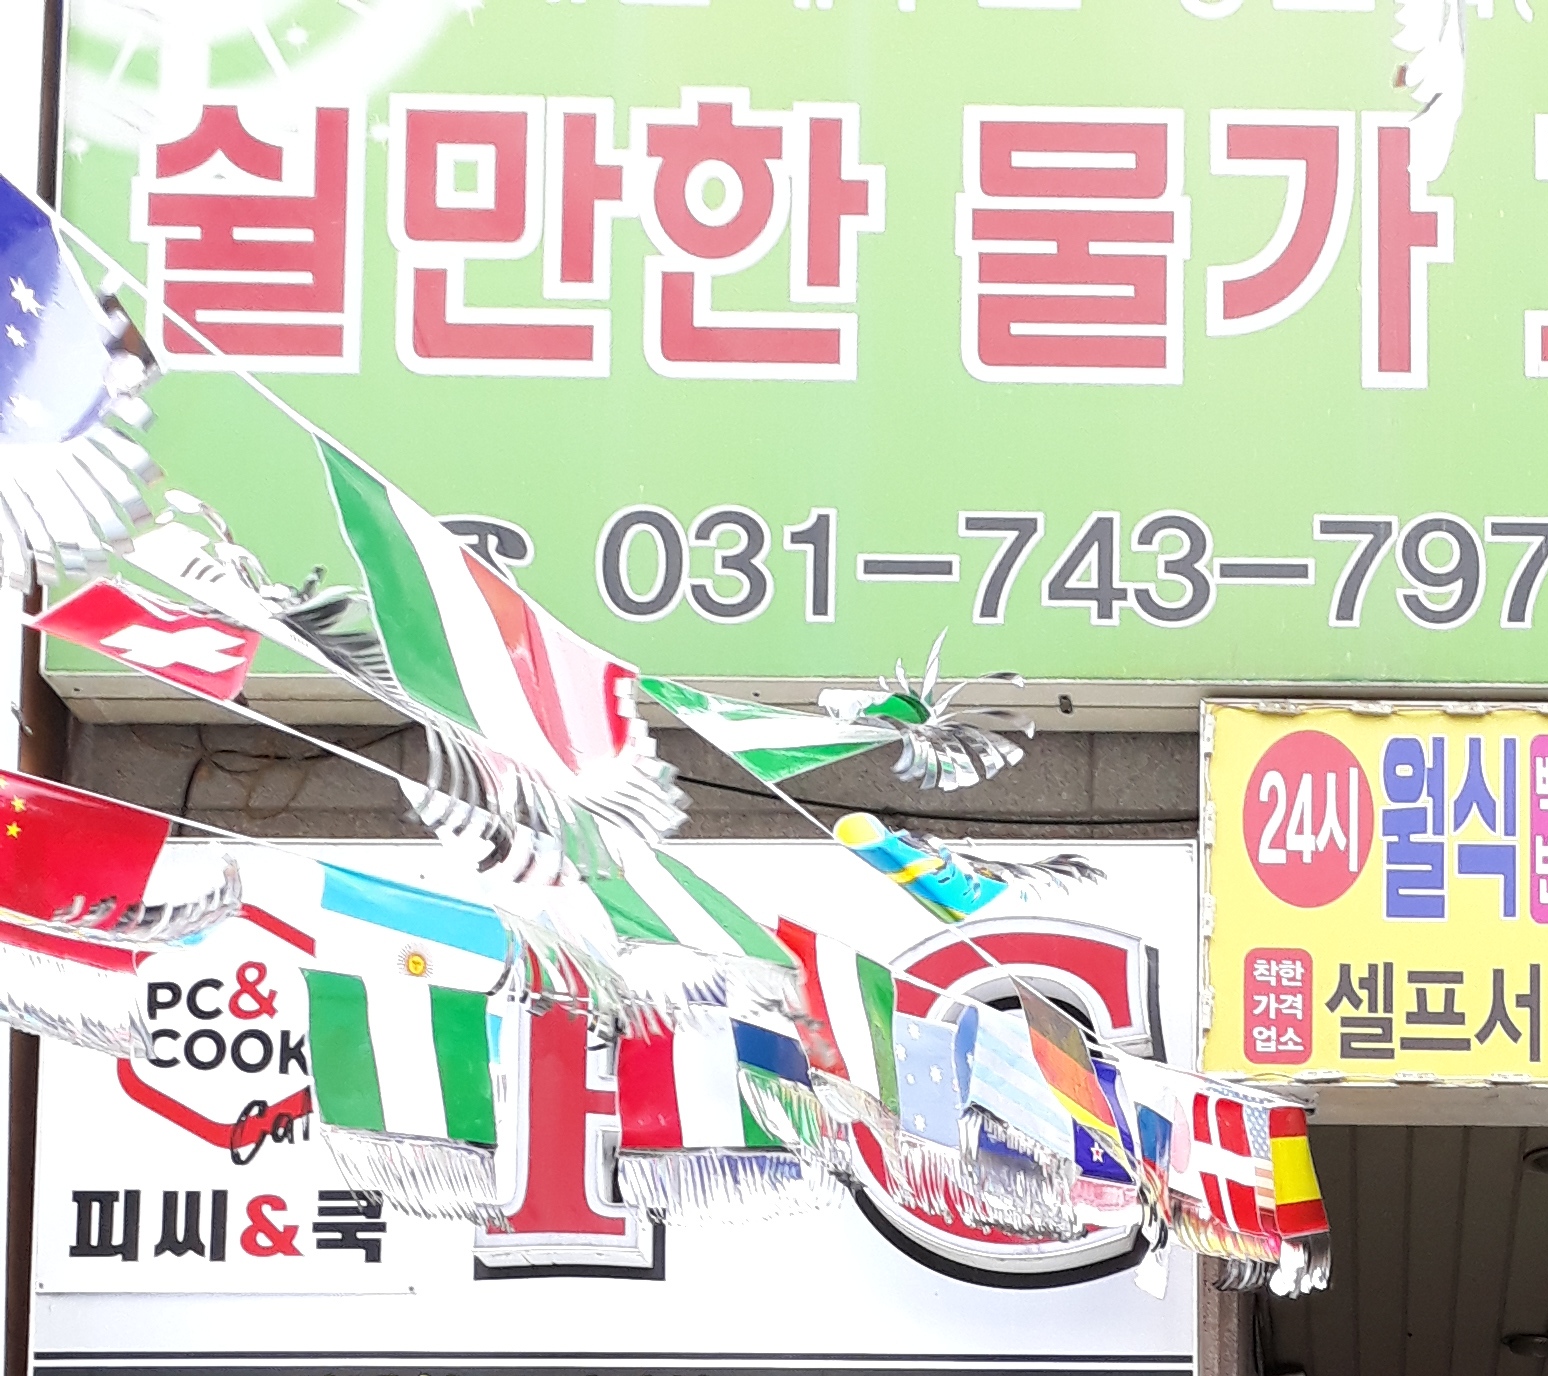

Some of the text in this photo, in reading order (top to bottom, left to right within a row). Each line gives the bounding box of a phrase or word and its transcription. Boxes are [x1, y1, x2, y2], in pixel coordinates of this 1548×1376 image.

[147, 101, 869, 358] 쉴만한
[971, 118, 1438, 375] 물가
[1257, 735, 1518, 920] 24시 월식
[147, 961, 278, 1020] PC&
[1254, 959, 1303, 987] 착한
[1253, 993, 1303, 1020] 가격
[148, 1029, 309, 1075] COOK
[1253, 1024, 1303, 1054] 업소
[70, 1189, 388, 1263] 피씨&쿡
